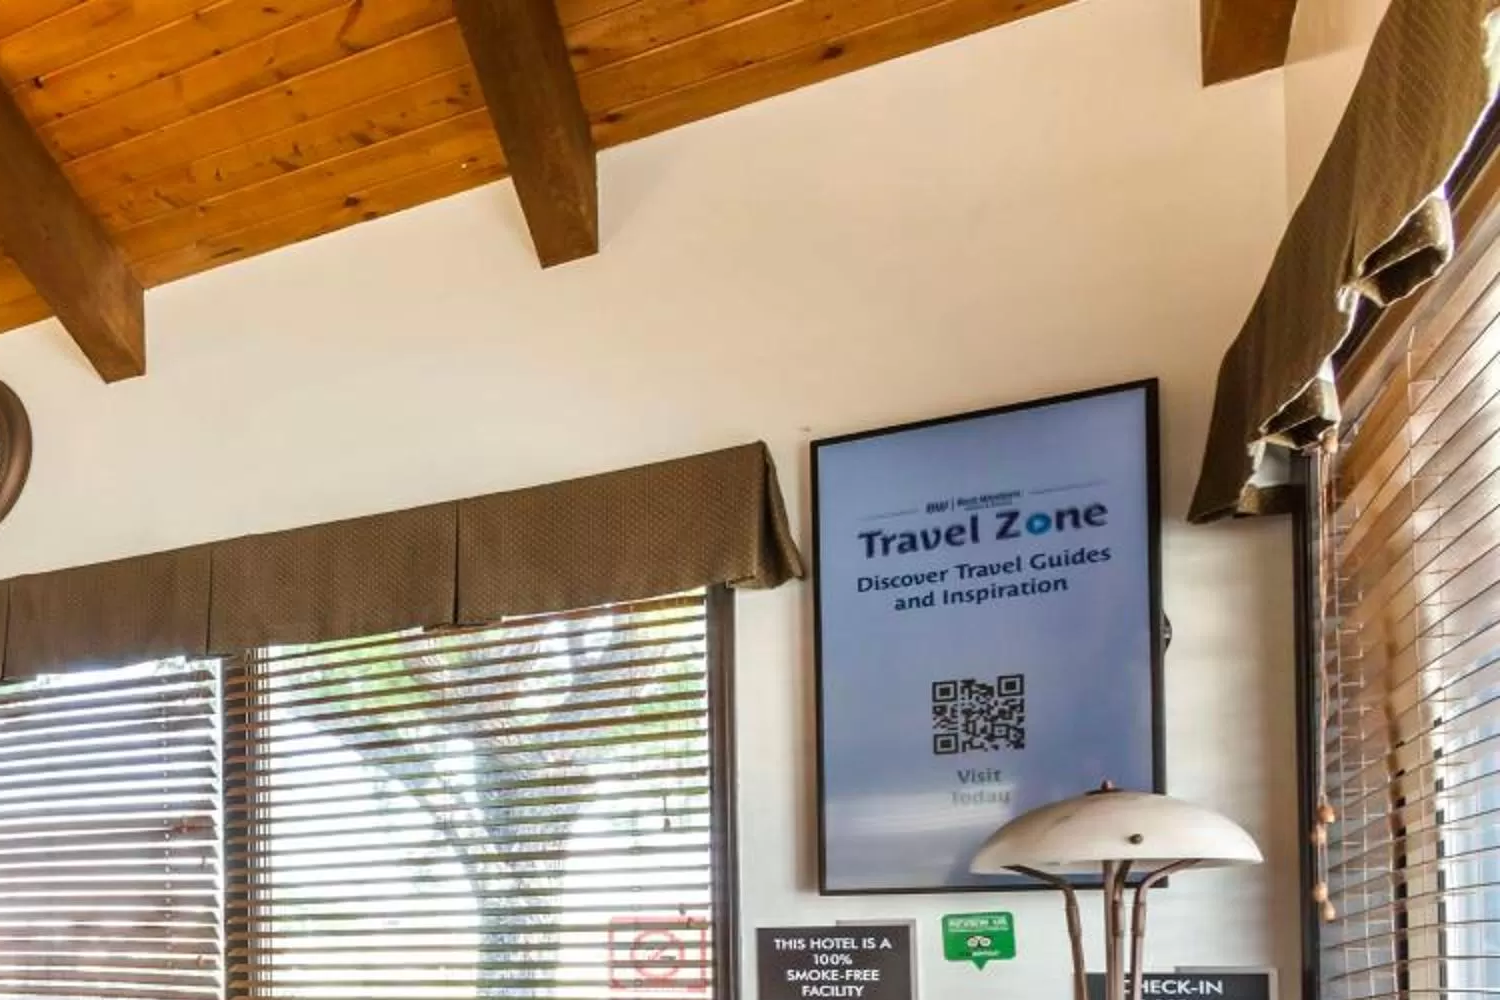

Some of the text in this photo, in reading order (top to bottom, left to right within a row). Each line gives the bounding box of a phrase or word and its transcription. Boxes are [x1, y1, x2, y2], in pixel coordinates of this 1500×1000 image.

[857, 502, 1109, 559] Travel Zone
[857, 547, 1112, 593] Discover Travel Guides
[894, 577, 1069, 611] and Inspiration
[956, 767, 1002, 785] Visit
[773, 937, 893, 950] THIS HOTEL IS A
[812, 953, 853, 966] 100%
[786, 969, 880, 982] SMOKE-FREE
[801, 985, 865, 998] FACILITY
